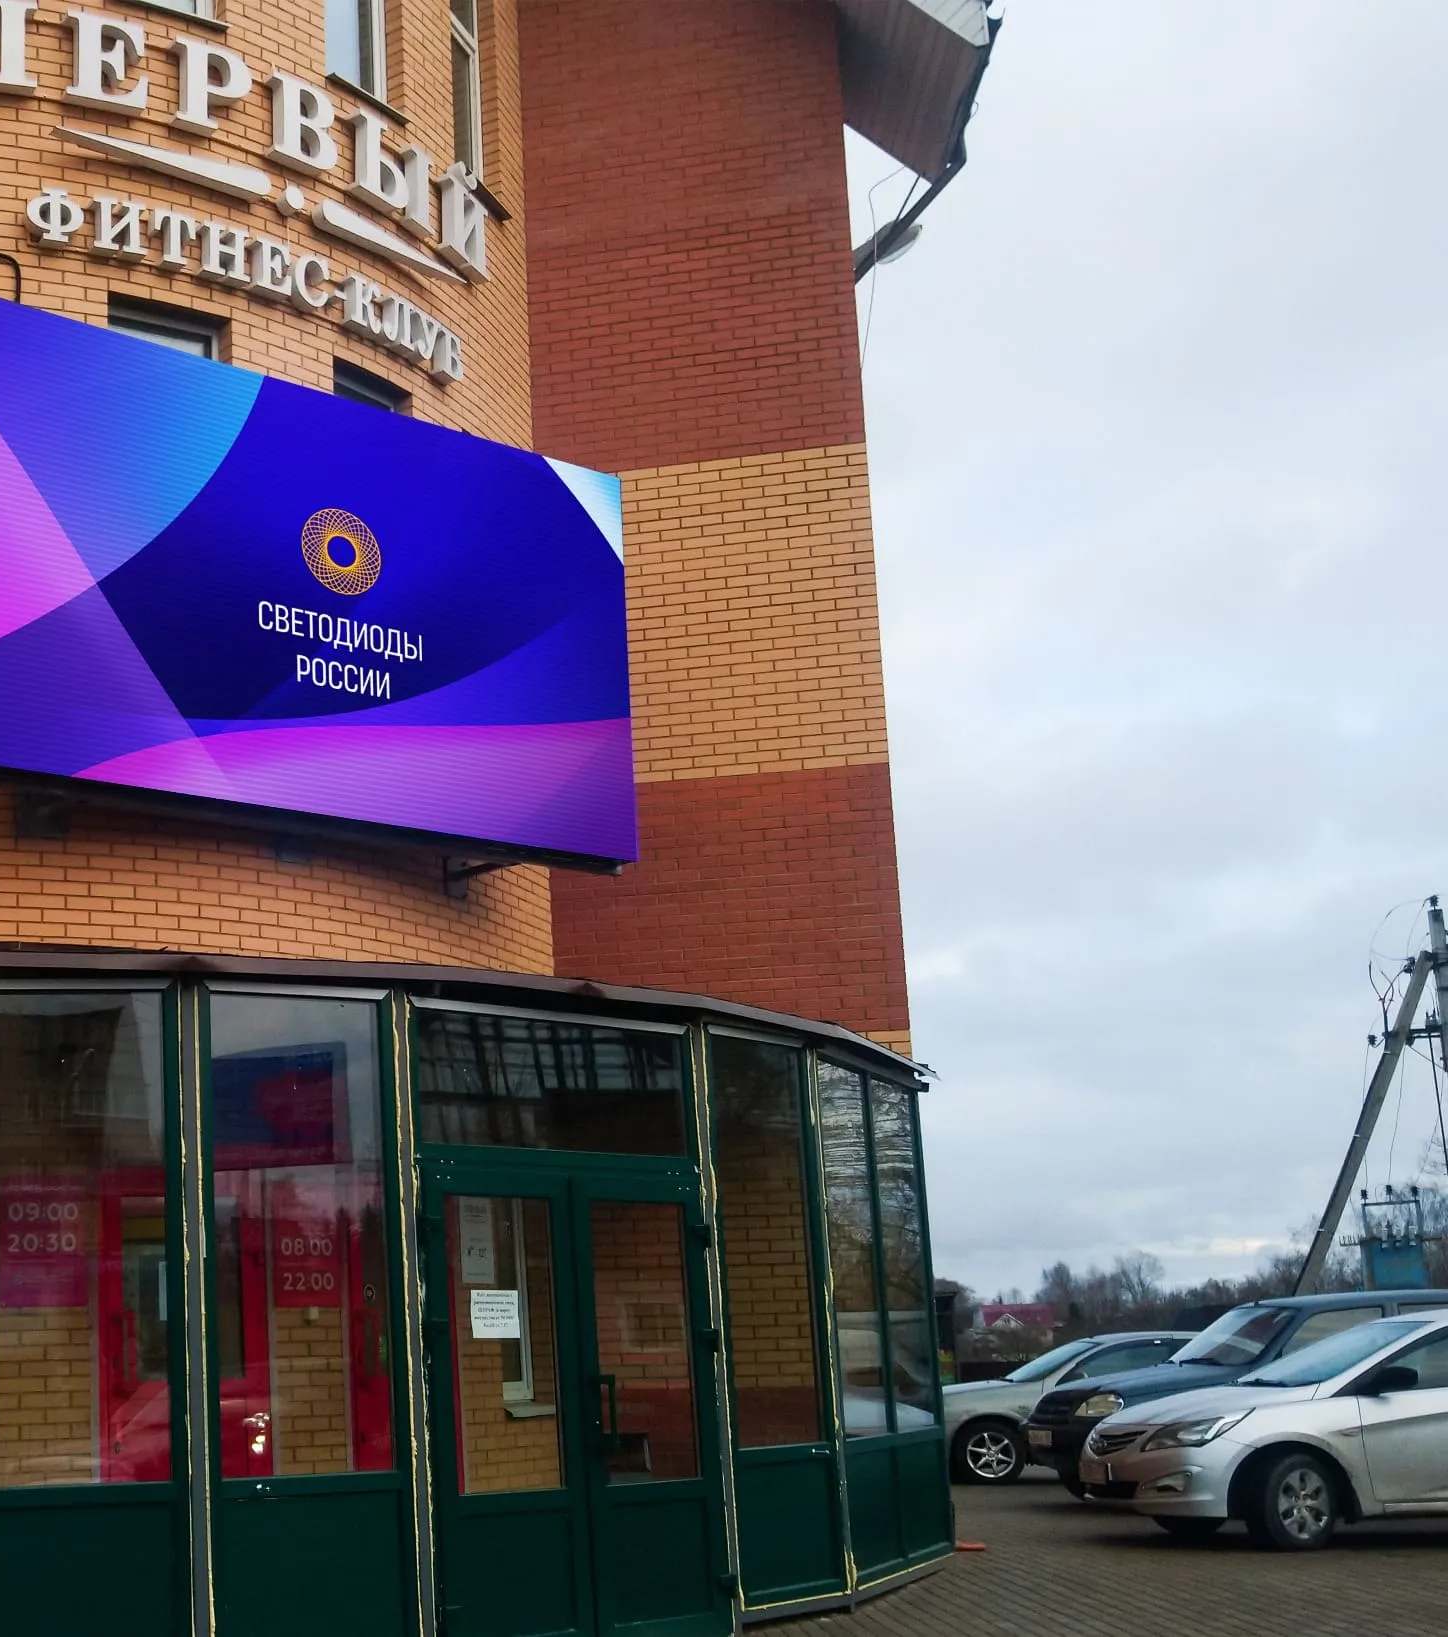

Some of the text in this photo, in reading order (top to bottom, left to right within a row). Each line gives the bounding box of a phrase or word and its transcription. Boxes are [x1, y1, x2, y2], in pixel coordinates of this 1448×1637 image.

[23, 186, 464, 386] ФИТНЕС-КЛУБ
[257, 600, 424, 662] СВЕТОДИОДЫ
[296, 654, 391, 700] РОССИИ
[8, 1202, 79, 1221] 09:00
[7, 1233, 77, 1252] 20:30
[280, 1238, 333, 1256] 0800
[283, 1272, 334, 1291] 22:00
